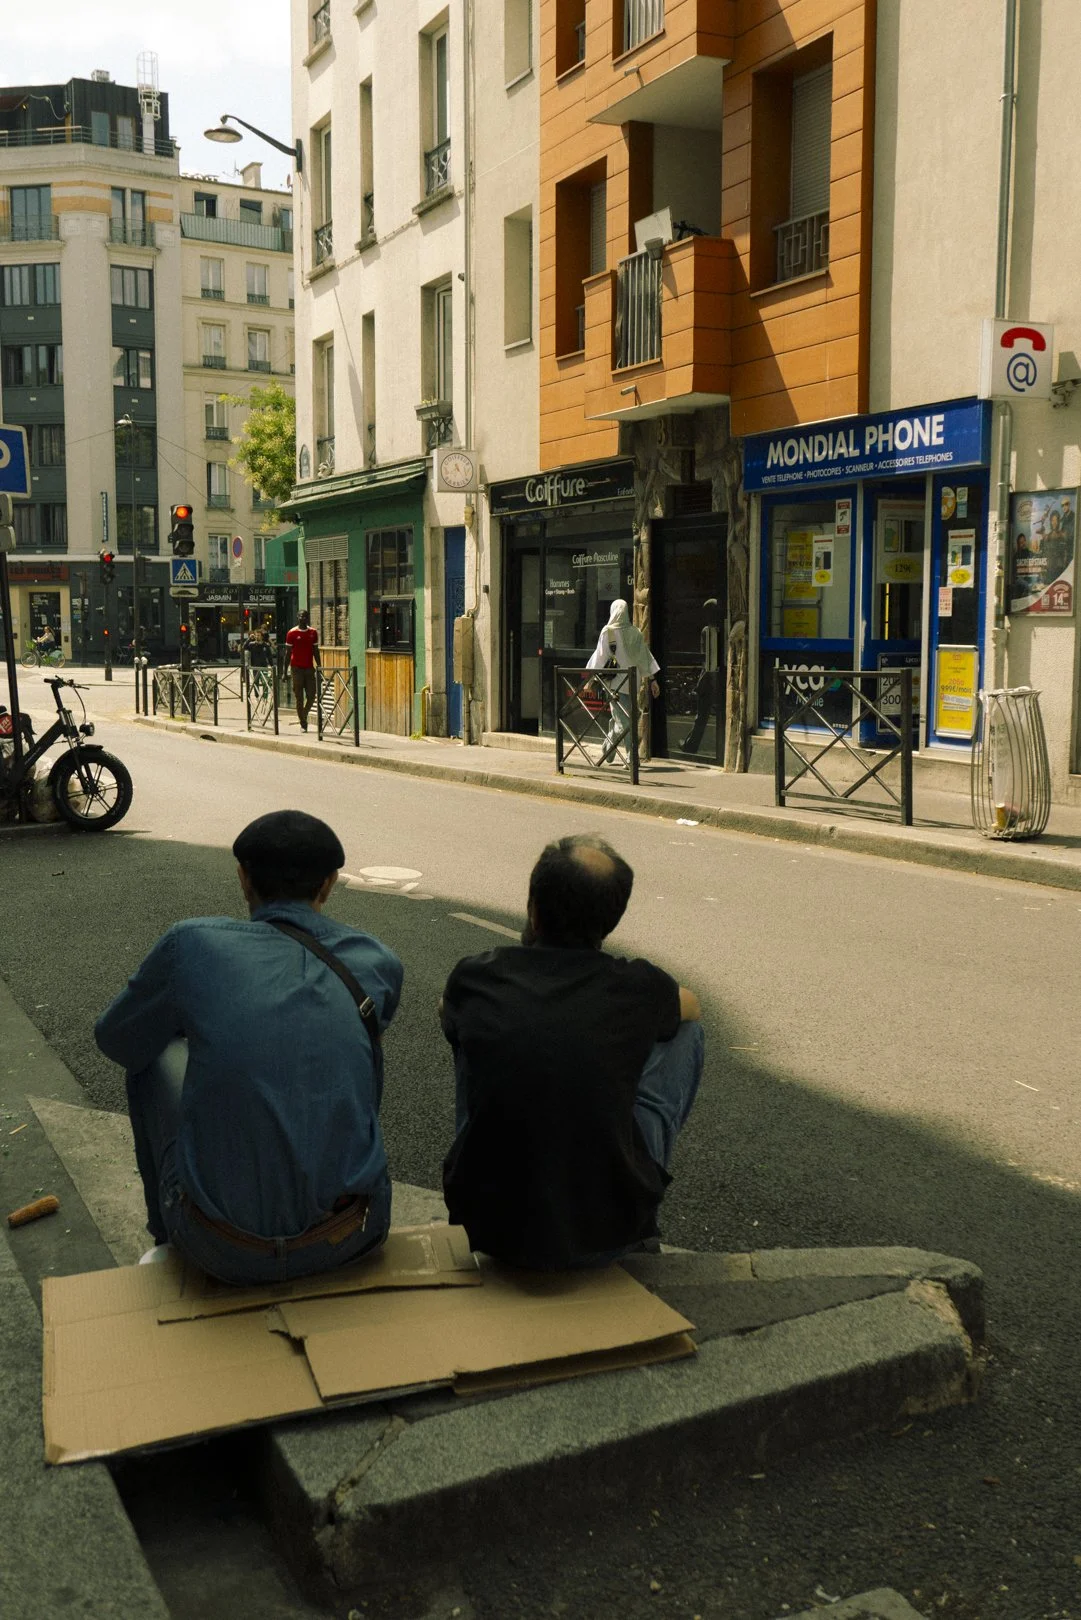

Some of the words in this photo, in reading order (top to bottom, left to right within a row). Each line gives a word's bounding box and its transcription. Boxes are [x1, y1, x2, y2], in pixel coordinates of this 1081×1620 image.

[766, 429, 860, 469] MONDIAL
[865, 414, 945, 455] PHONE
[761, 475, 776, 484] VENTE
[777, 471, 803, 483] TELEPHONE
[807, 467, 841, 479] PHOTOCOPIES
[845, 462, 874, 474] SCANNEUR
[878, 456, 915, 470] ACCESSOIRES
[916, 451, 953, 465] TELEPHONES
[525, 473, 585, 506] Coiffure
[572, 553, 592, 566] Coiffure
[593, 551, 619, 563] Masculine
